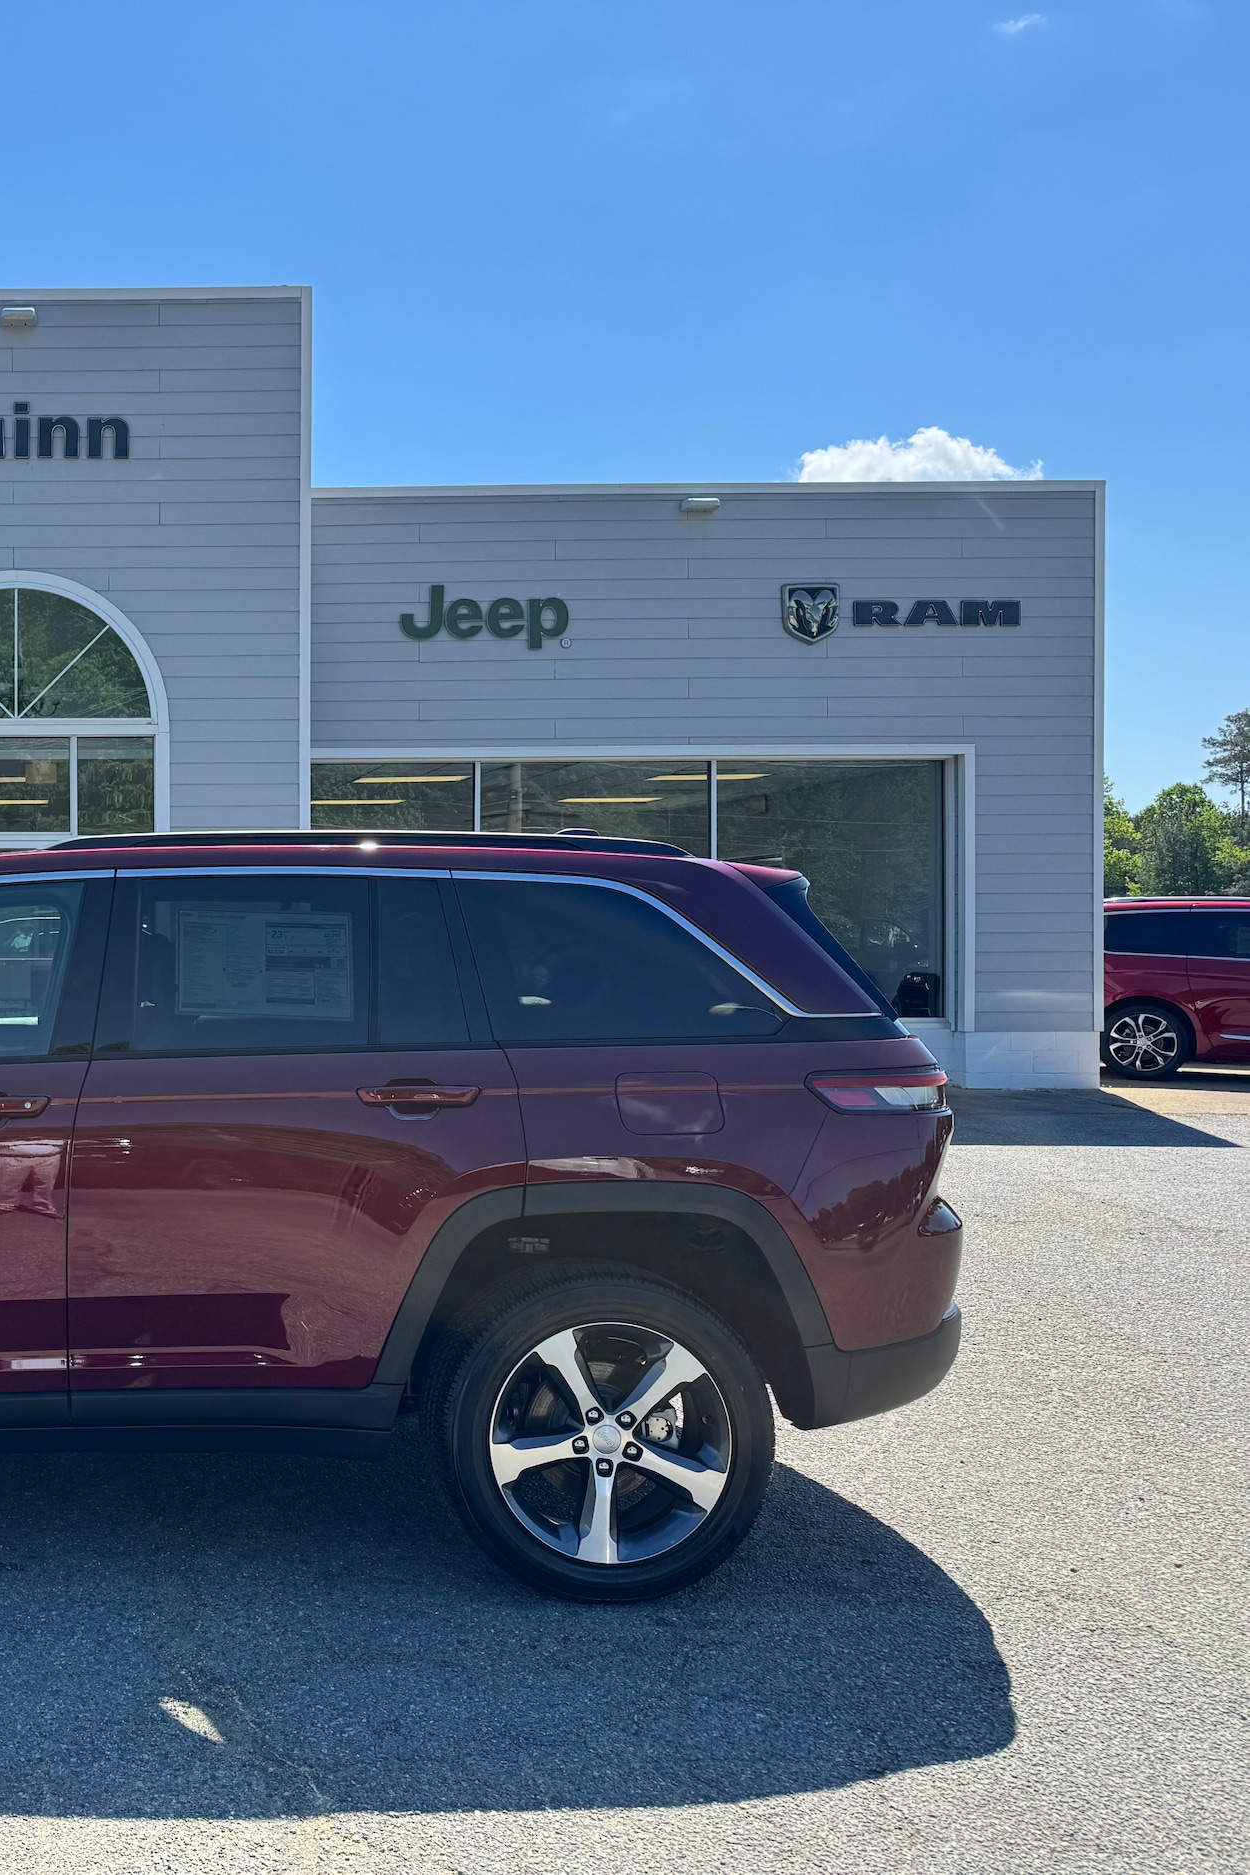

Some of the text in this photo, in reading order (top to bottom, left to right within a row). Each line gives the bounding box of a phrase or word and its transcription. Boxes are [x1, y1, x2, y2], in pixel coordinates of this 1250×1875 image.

[400, 585, 569, 650] Jeep
[853, 600, 1022, 627] RAM
[270, 930, 283, 938] 23
